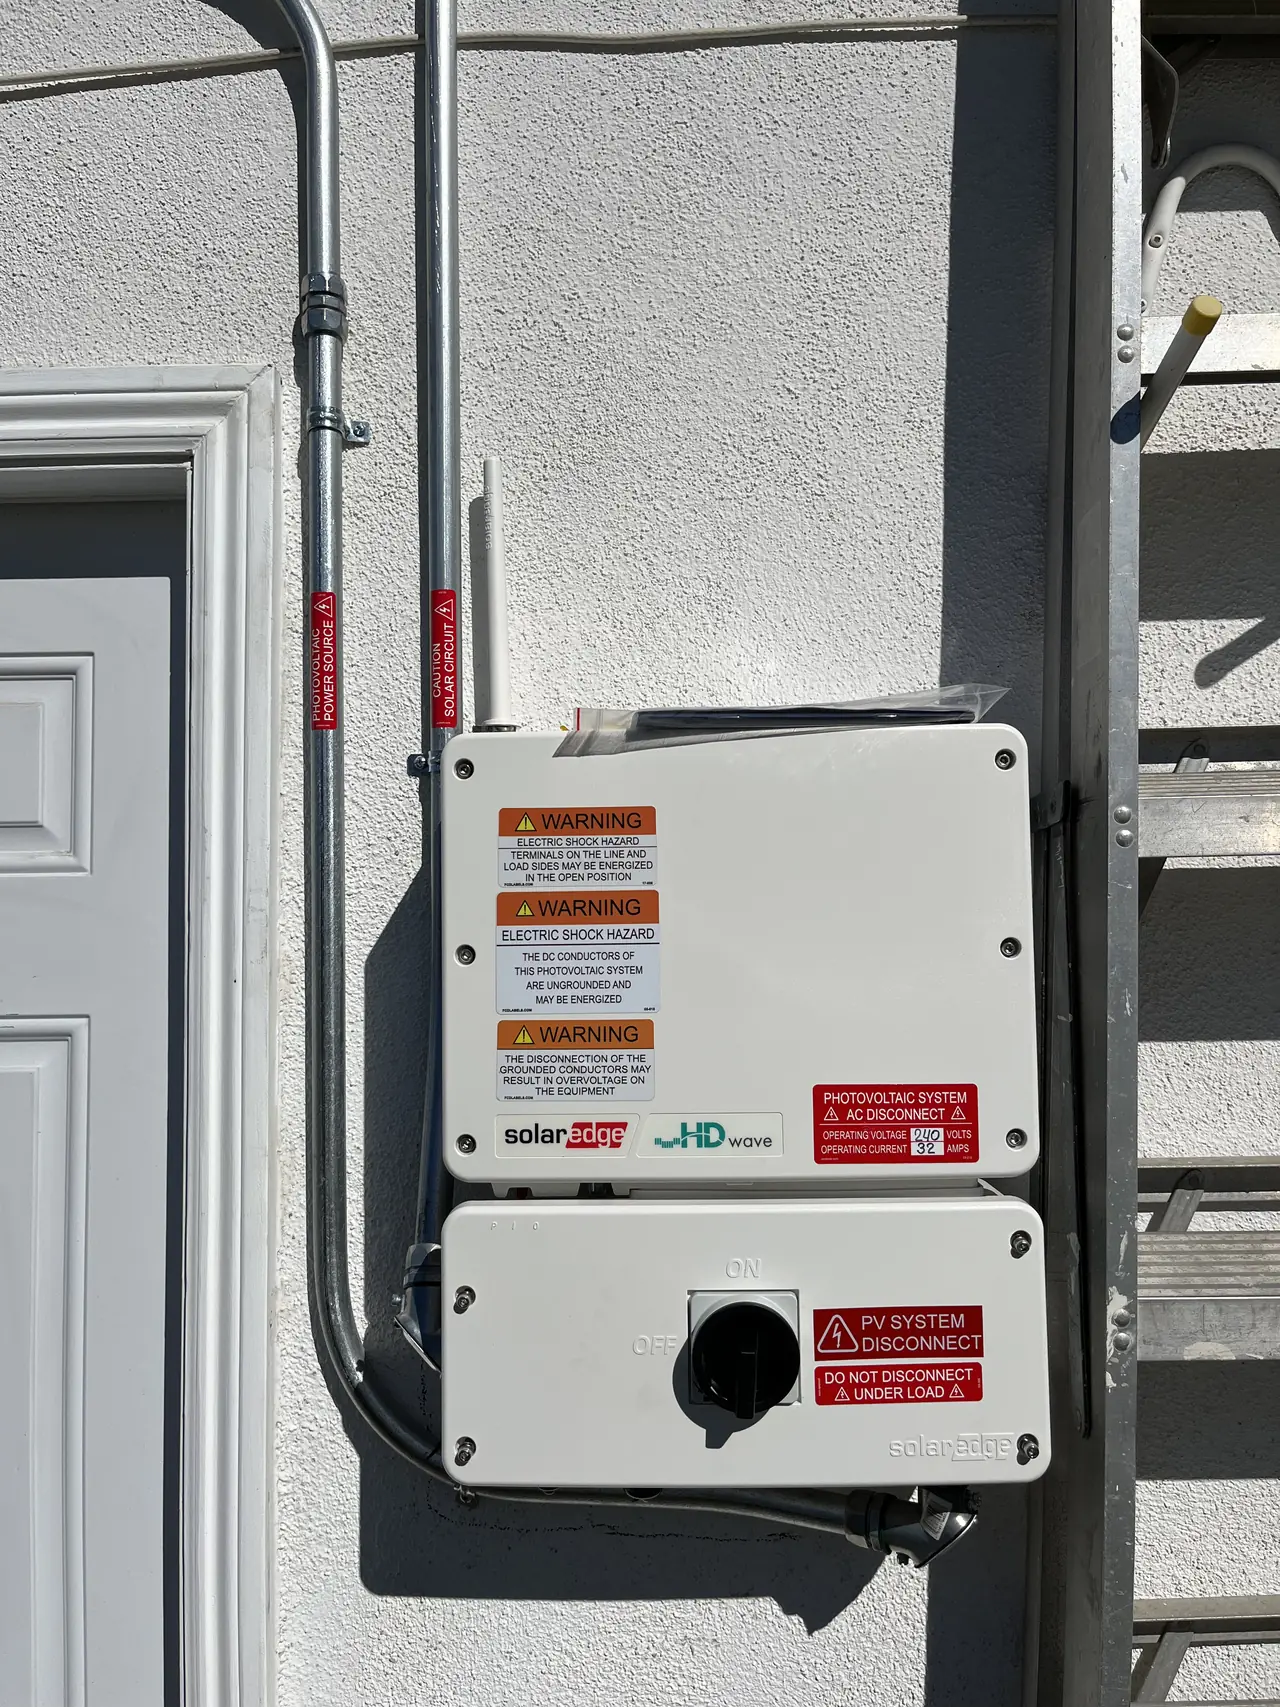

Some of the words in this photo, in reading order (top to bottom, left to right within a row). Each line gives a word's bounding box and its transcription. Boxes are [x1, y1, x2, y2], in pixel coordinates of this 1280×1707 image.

[323, 620, 333, 672] SOURCE
[443, 623, 454, 673] CIRCUIT
[312, 629, 321, 721] PHOTOVOLTAIC
[433, 643, 441, 698] CAUTION
[323, 675, 334, 721] POWER
[444, 676, 454, 717] SOLAR
[541, 813, 642, 829] WARNING
[517, 838, 563, 847] ELECTRIC
[566, 838, 599, 846] SHOCK
[602, 837, 639, 845] HAZARD
[511, 851, 563, 859] TERMINALS
[567, 851, 580, 859] ON
[628, 850, 646, 858] AND
[504, 862, 529, 871] LOAD
[532, 862, 559, 870] SIDES
[562, 862, 582, 870] MAY
[599, 861, 653, 869] ENERGIZED
[526, 874, 534, 882] IN
[538, 874, 555, 882] THE
[558, 873, 584, 881] OPEN
[588, 873, 631, 881] POSITION
[538, 899, 641, 916] WARNING
[502, 930, 559, 941] ELECTRIC
[562, 929, 604, 940] SHOCK
[607, 928, 654, 939] HAZARD
[523, 953, 540, 961] THE
[542, 953, 555, 961] DC
[558, 952, 620, 961] CONDUCTORS
[622, 952, 635, 960] OF
[515, 967, 534, 975] THIS
[537, 967, 605, 975] PHOTOVOLTAIC
[607, 966, 643, 974] SYSTEM
[526, 982, 544, 990] ARE
[547, 981, 611, 989] UNGROUNDED
[612, 980, 631, 989] AND
[536, 996, 554, 1004] MAY
[557, 995, 568, 1003] BE
[571, 995, 622, 1003] ENERGIZED
[540, 1026, 639, 1043] WARNING
[505, 1055, 524, 1063] THE
[527, 1055, 608, 1063] DISCONNECTION
[627, 1054, 646, 1062] THE
[500, 1066, 556, 1074] GROUNDED
[559, 1066, 628, 1074] CONDUCTORS
[503, 1077, 541, 1085] RESULT
[555, 1076, 627, 1084] OVERVOLTAGE
[630, 1076, 645, 1084] ON
[558, 1087, 615, 1096] EQUIPMENT
[824, 1092, 915, 1104] PHOTOVOLTAIC
[918, 1092, 967, 1104] SYSTEM
[847, 1109, 863, 1121] AC
[867, 1108, 945, 1120] DISCONNECT
[505, 1122, 625, 1148] solaredge
[823, 1131, 869, 1140] OPERATING
[871, 1131, 907, 1139] VOLTAGE
[914, 1129, 940, 1142] 240
[947, 1130, 972, 1139] VOLTS
[728, 1136, 772, 1148] wave
[821, 1145, 867, 1154] OPERATING
[869, 1145, 907, 1153] CURRENT
[917, 1143, 935, 1154] 32
[947, 1144, 969, 1152] AMPS
[725, 1258, 762, 1279] ON
[861, 1315, 885, 1330] PV
[890, 1313, 965, 1329] SYSTEM
[632, 1335, 677, 1356] OFF
[862, 1335, 982, 1352] DISCONNECT
[825, 1371, 845, 1384] DO
[849, 1370, 878, 1383] NOT
[882, 1369, 973, 1383] DISCONNECT
[854, 1387, 904, 1400] UNDER
[908, 1386, 945, 1399] LOAD
[889, 1433, 1014, 1461] solaredge
